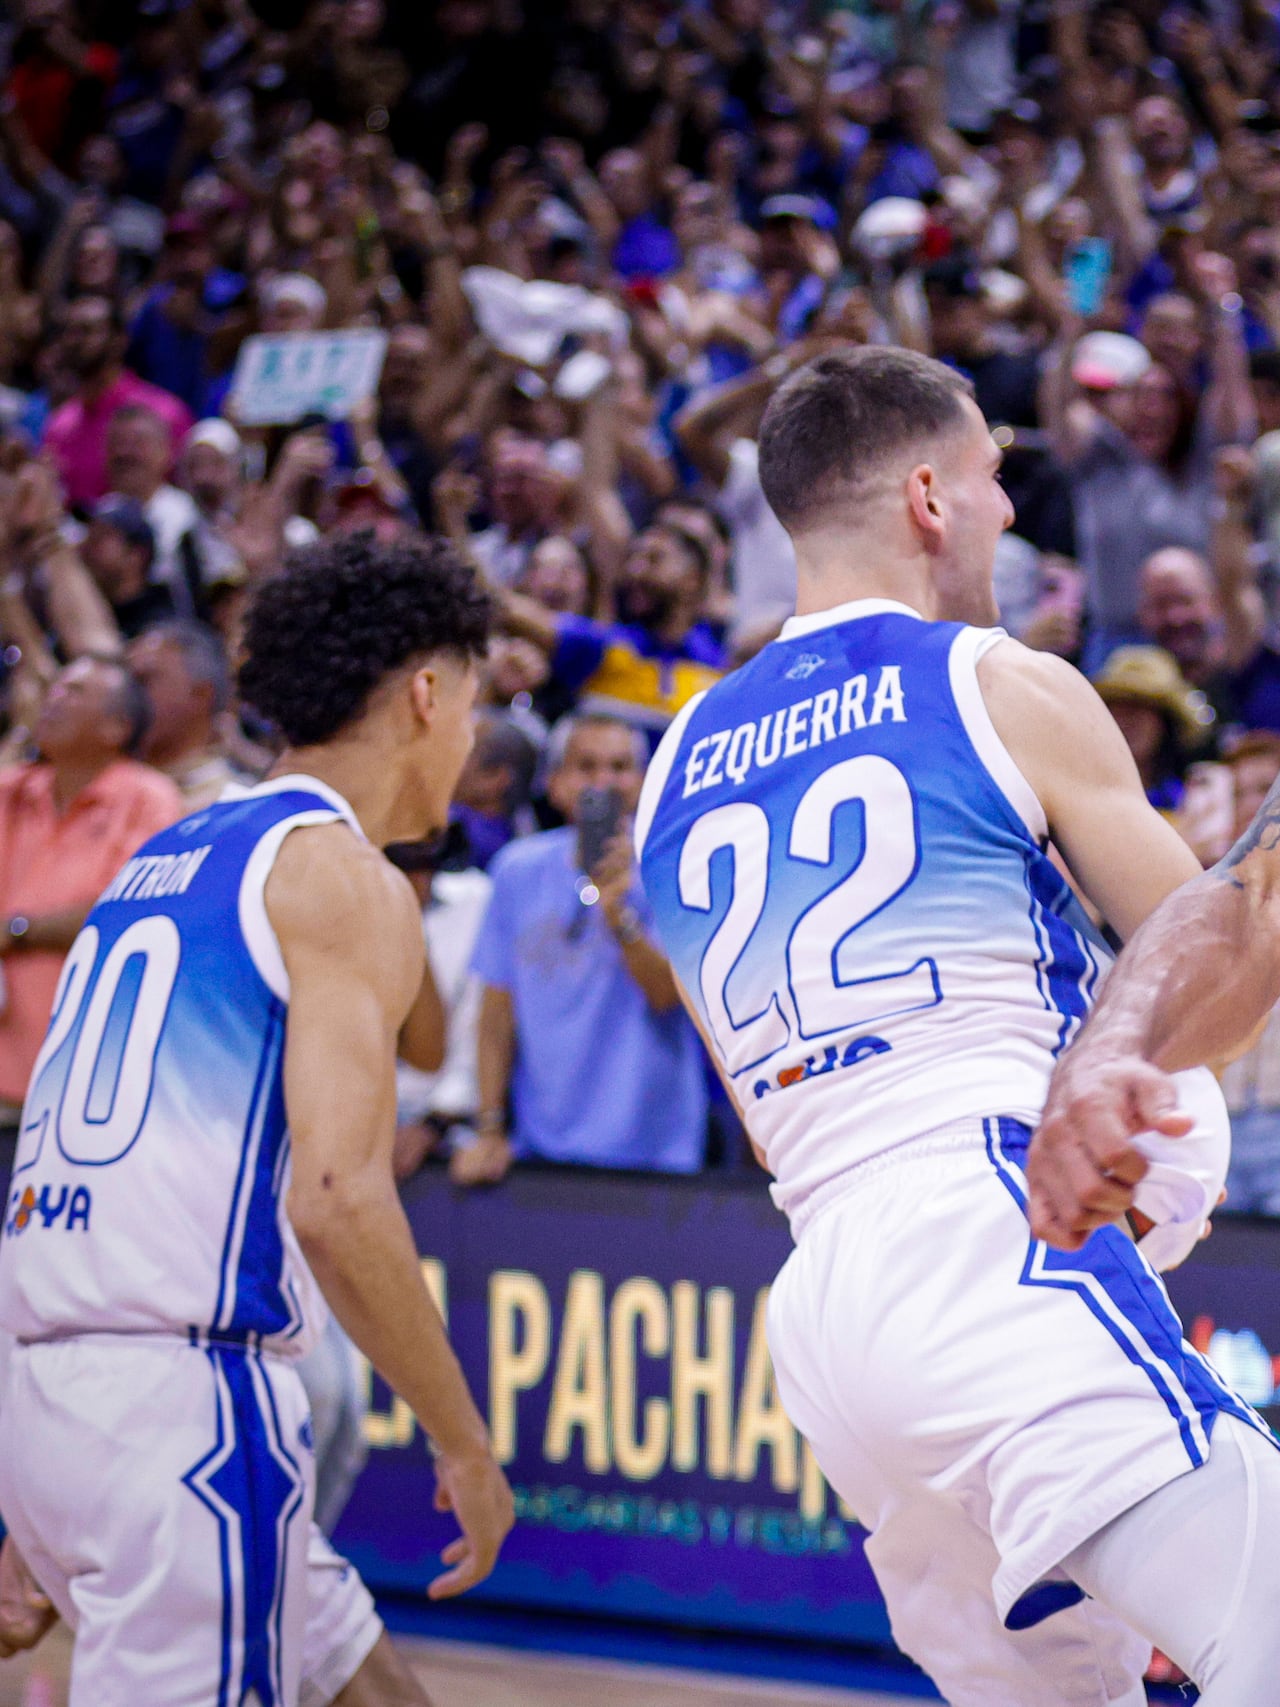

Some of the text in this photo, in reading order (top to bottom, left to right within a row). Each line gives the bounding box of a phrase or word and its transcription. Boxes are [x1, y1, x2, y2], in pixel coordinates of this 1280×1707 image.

[682, 665, 908, 799] EZQUERRA
[12, 914, 181, 1166] 20
[678, 754, 943, 1079] 22
[487, 1268, 860, 1522] PACHA
